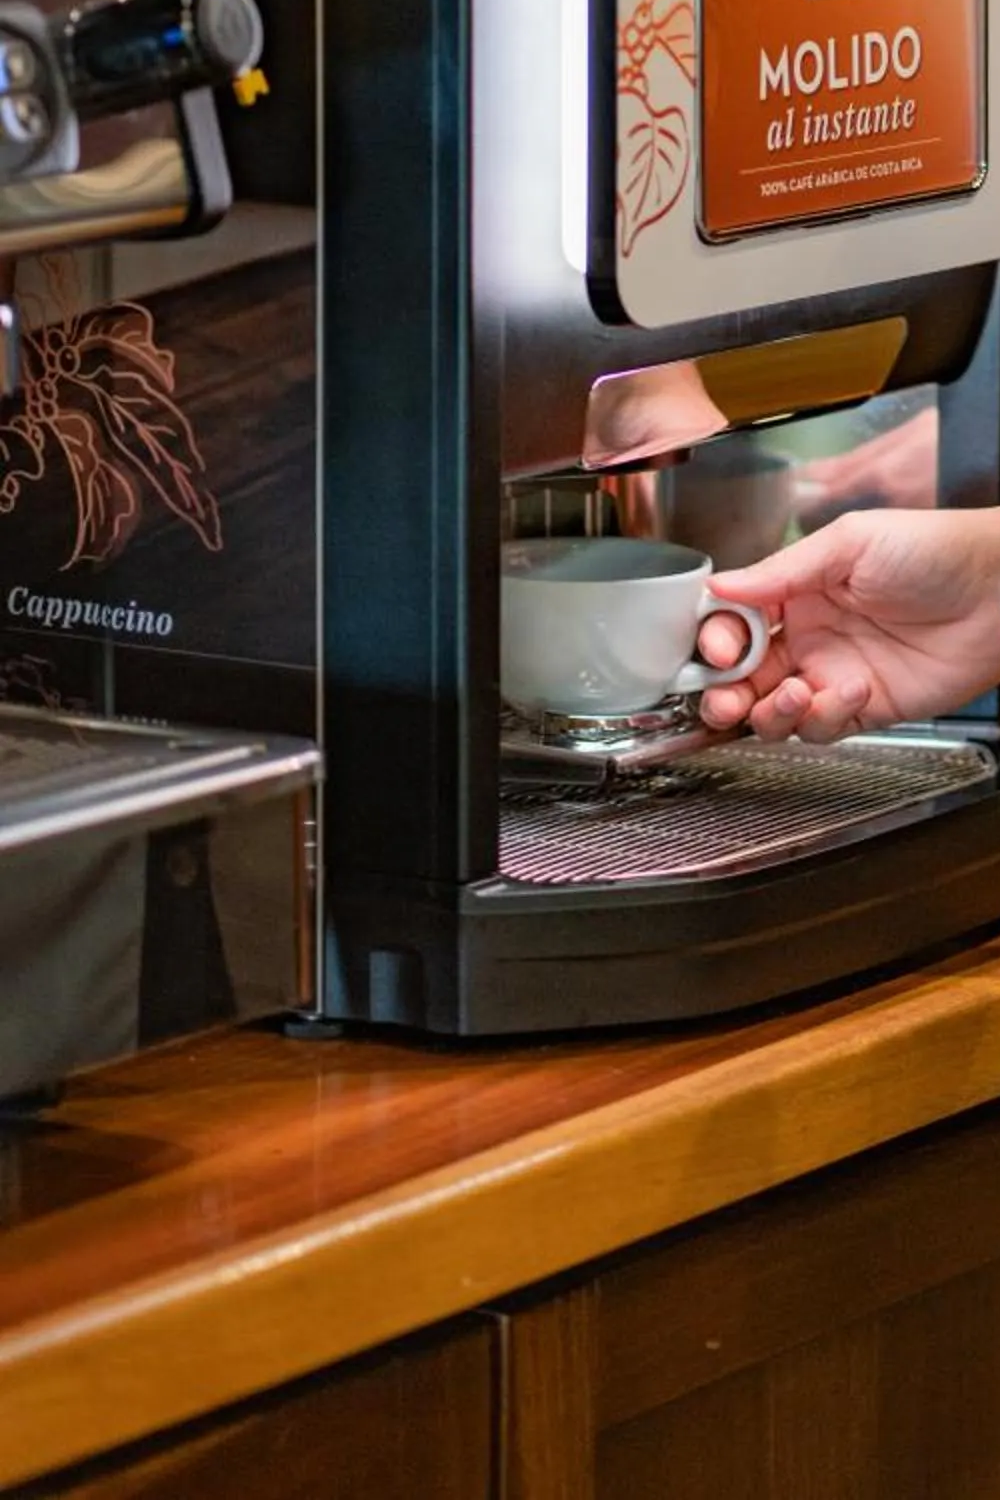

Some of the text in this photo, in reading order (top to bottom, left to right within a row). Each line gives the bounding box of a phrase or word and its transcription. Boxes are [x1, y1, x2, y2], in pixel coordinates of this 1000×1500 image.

[759, 25, 921, 100] MOLIDO
[767, 96, 915, 150] al instante
[760, 181, 788, 197] 100%
[790, 172, 813, 191] CAFÉ
[855, 165, 868, 180] DE
[869, 162, 900, 177] COSTA
[901, 157, 923, 171] RICA
[7, 586, 173, 635] Cappuccino
